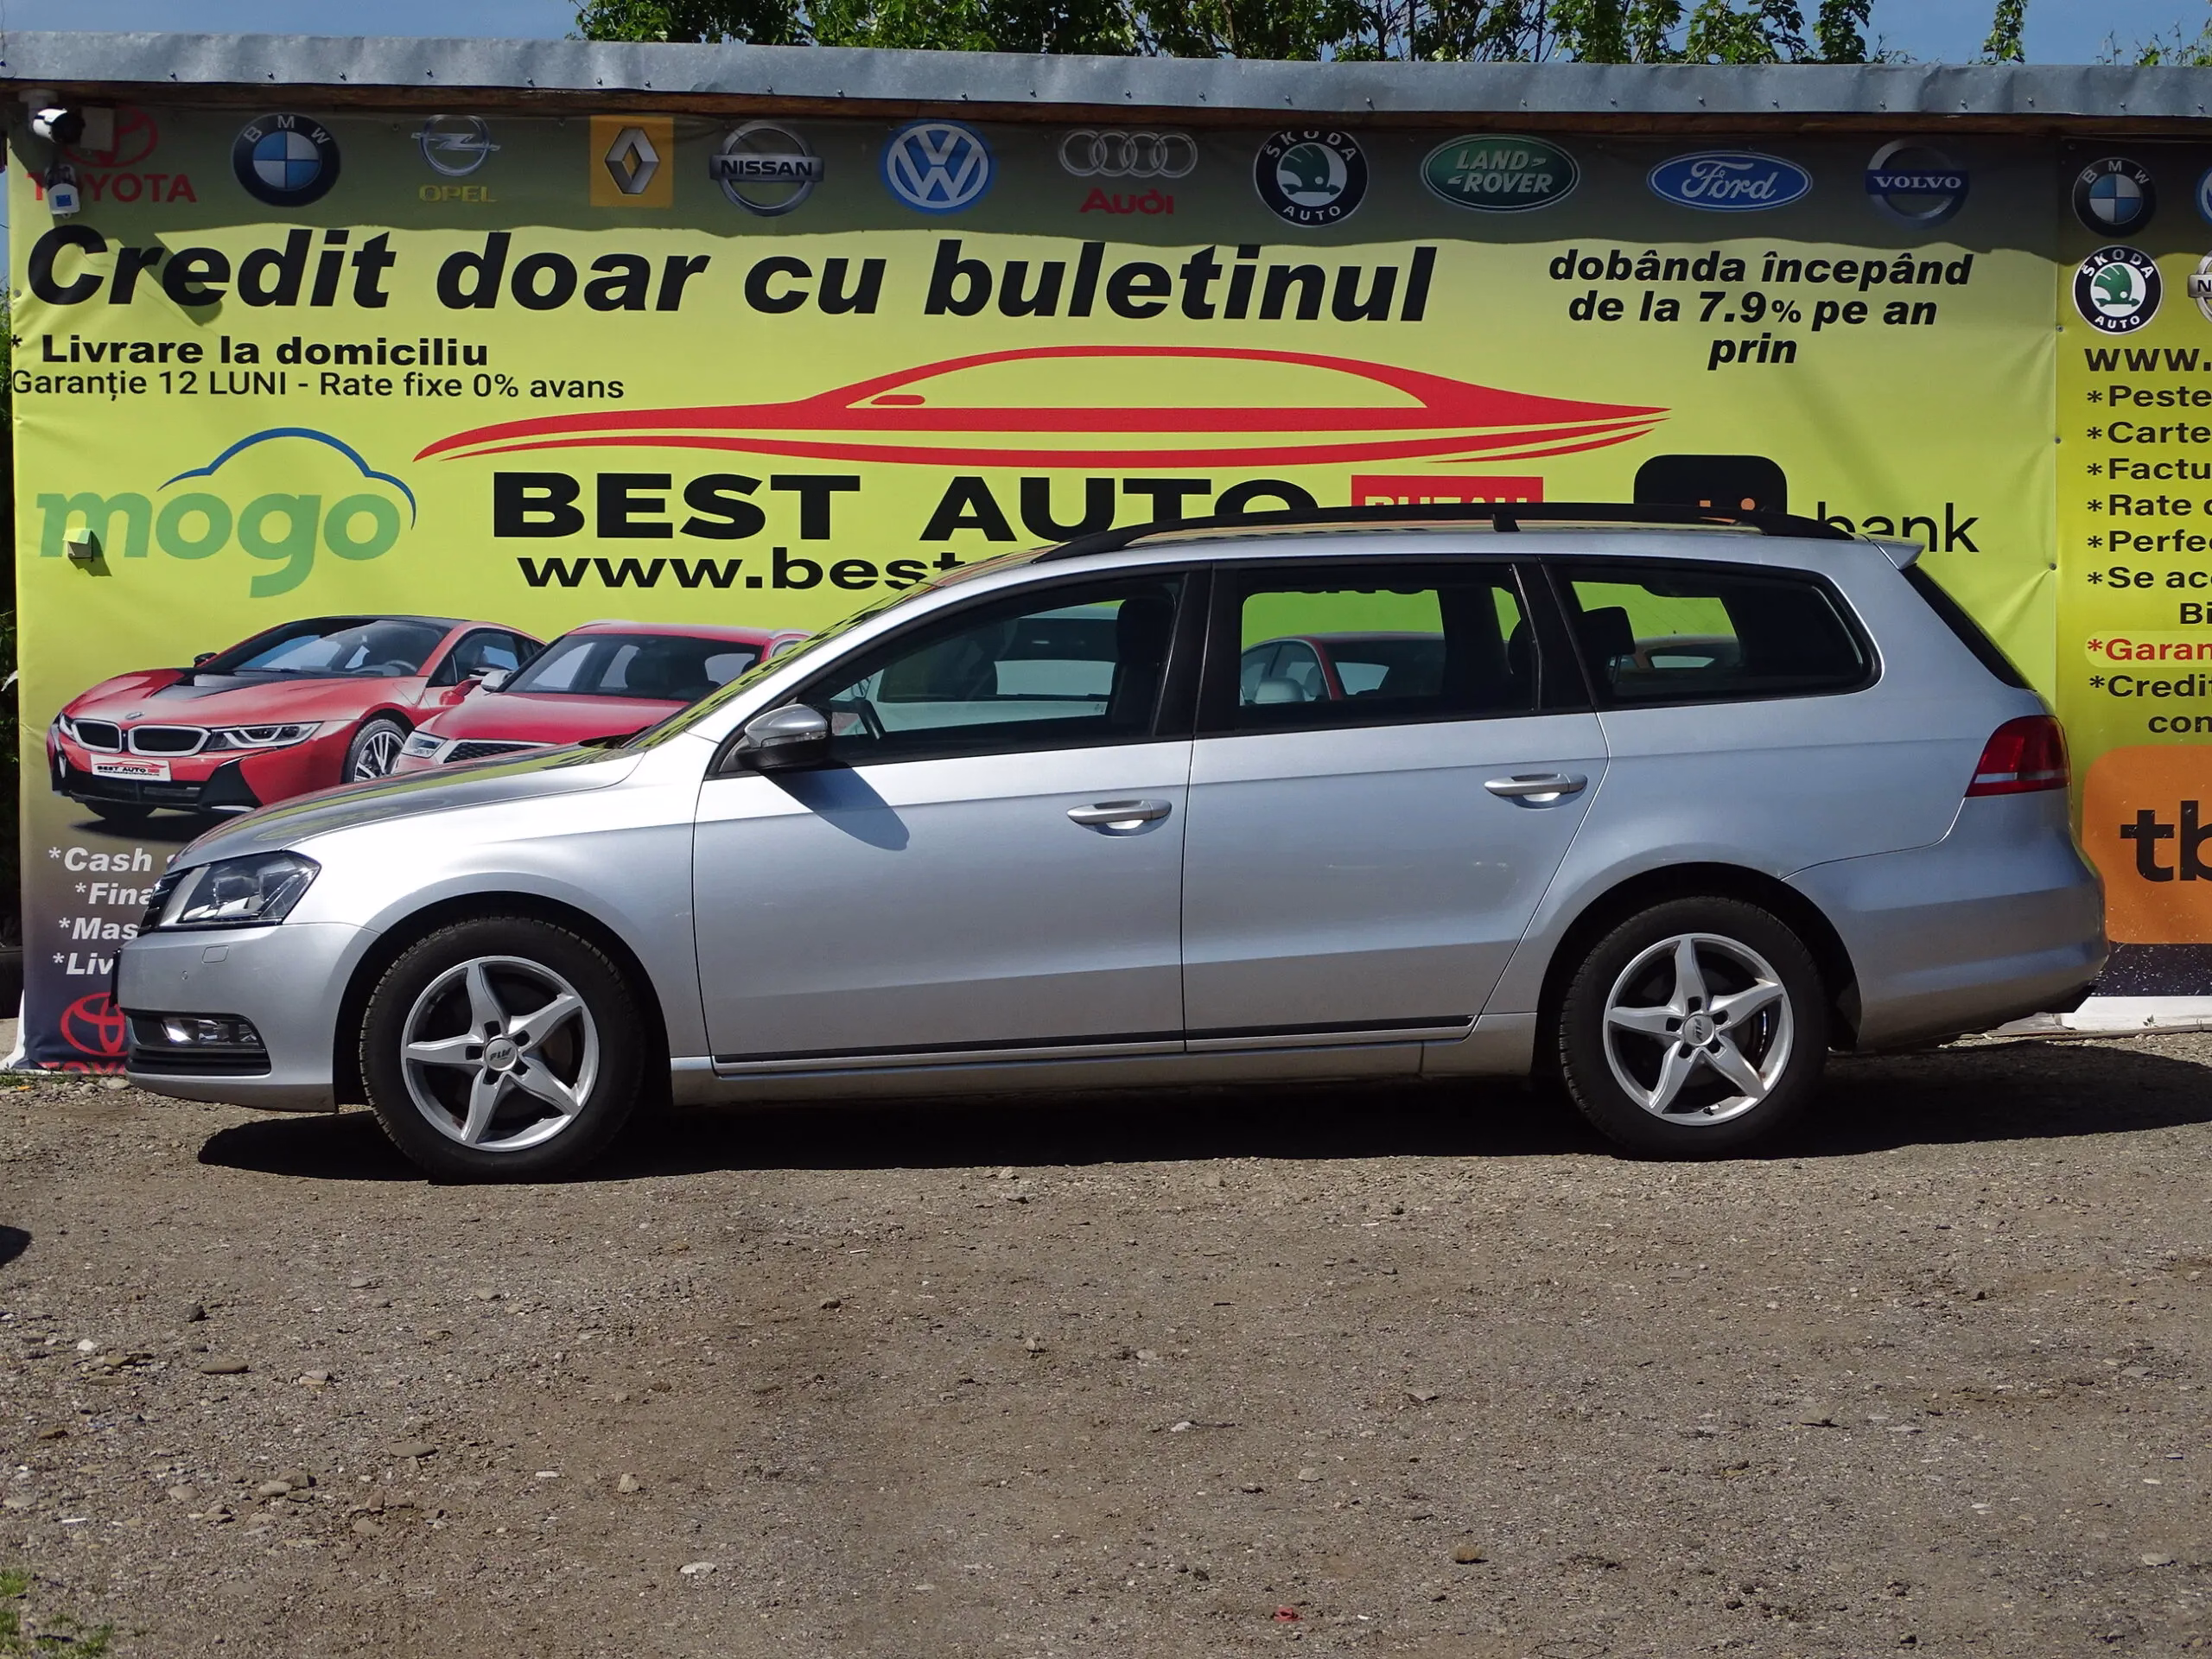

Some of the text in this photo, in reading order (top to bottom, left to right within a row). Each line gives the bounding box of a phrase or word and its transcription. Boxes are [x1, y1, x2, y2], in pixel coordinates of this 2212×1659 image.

[244, 115, 330, 143] BMW
[720, 159, 813, 177] NISSAN
[1455, 149, 1529, 170] LAND
[2081, 161, 2149, 184] BMW
[26, 172, 197, 203] TYOTA
[419, 185, 496, 202] OPEL
[1463, 173, 1553, 193] ROVER
[1681, 160, 1779, 200] Ford
[1873, 175, 1961, 188] VOLVO
[1283, 206, 1341, 220] AUTO
[28, 224, 1437, 322] Credit doar cu buletinul
[1549, 249, 1974, 291] dobânda începând
[2082, 249, 2154, 278] ŠKODA
[1568, 290, 1624, 321] de
[1639, 291, 1680, 321] la
[1811, 300, 1868, 331] pe
[1883, 300, 1937, 325] an
[2094, 315, 2140, 329] AUTO
[42, 334, 487, 365] Livrare la domiciliu
[1707, 333, 1797, 370] prin
[159, 371, 198, 395] 12
[210, 372, 286, 396] LUNI
[321, 372, 392, 396] Rate
[404, 372, 462, 397] fixe
[474, 373, 519, 397] 0%
[530, 379, 624, 398] avans
[493, 472, 860, 540] BEST
[36, 492, 401, 598] mogo
[2087, 529, 2212, 552] Perfe
